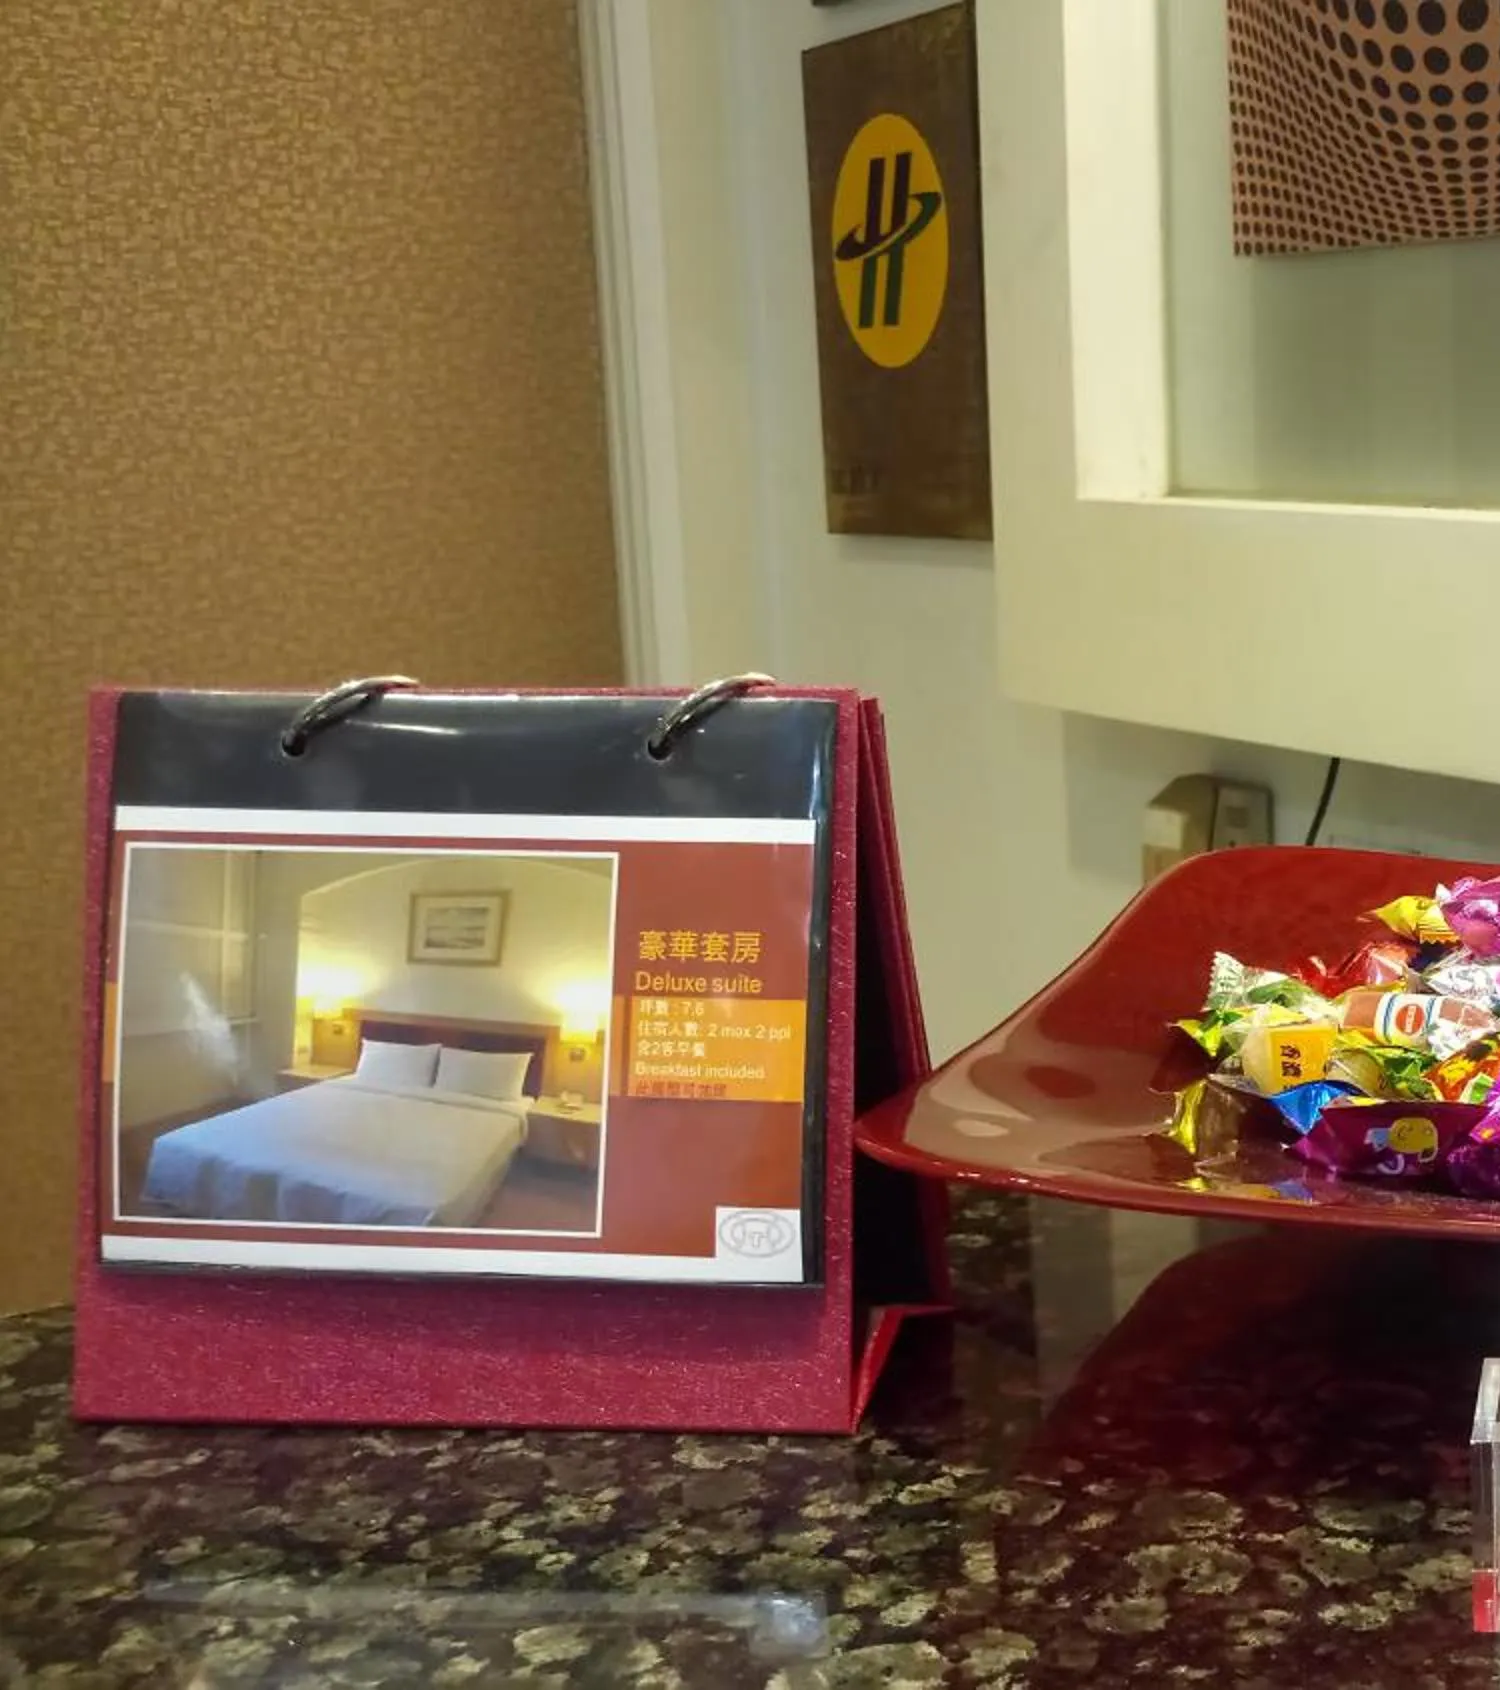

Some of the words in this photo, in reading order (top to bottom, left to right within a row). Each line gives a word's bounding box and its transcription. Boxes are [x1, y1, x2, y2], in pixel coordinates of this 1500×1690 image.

[639, 930, 762, 963] 豪華套房
[635, 970, 707, 993] Deluxe
[711, 974, 762, 994] suite
